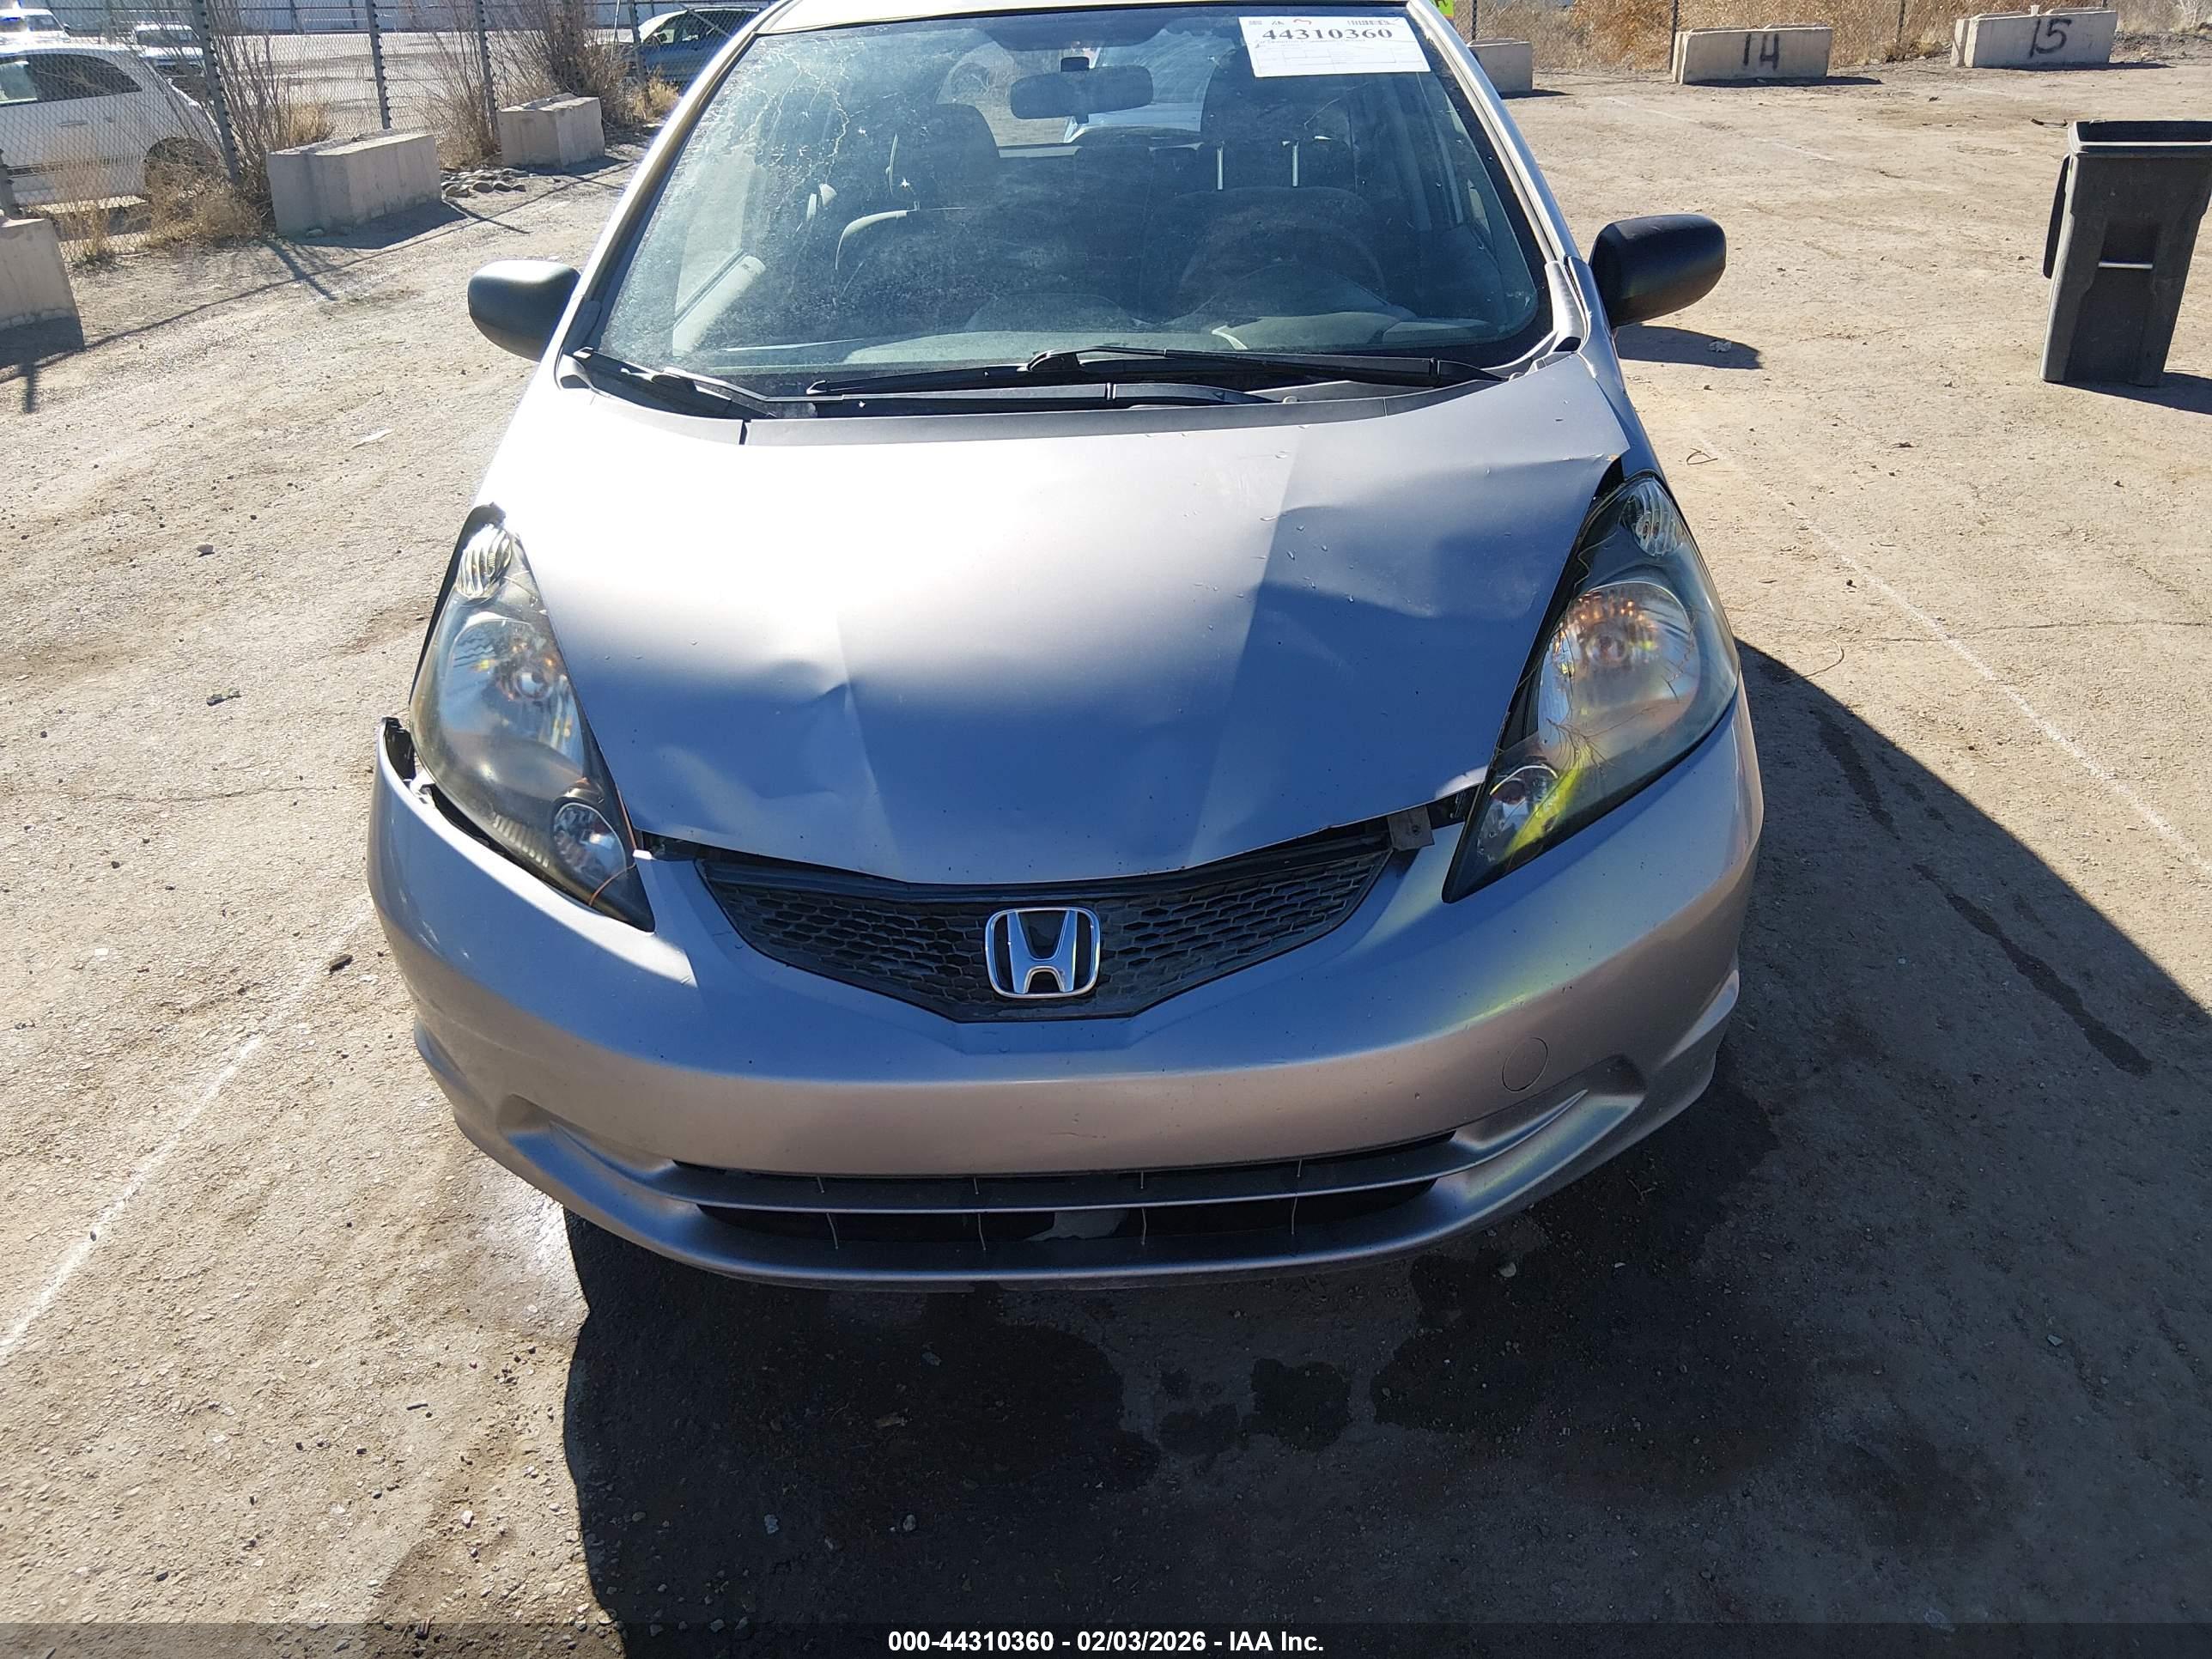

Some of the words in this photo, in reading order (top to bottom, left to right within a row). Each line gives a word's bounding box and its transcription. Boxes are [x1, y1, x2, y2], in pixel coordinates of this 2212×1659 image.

[1261, 28, 1393, 40] 44310360
[1741, 33, 1780, 70] 14
[2028, 17, 2072, 58] 15
